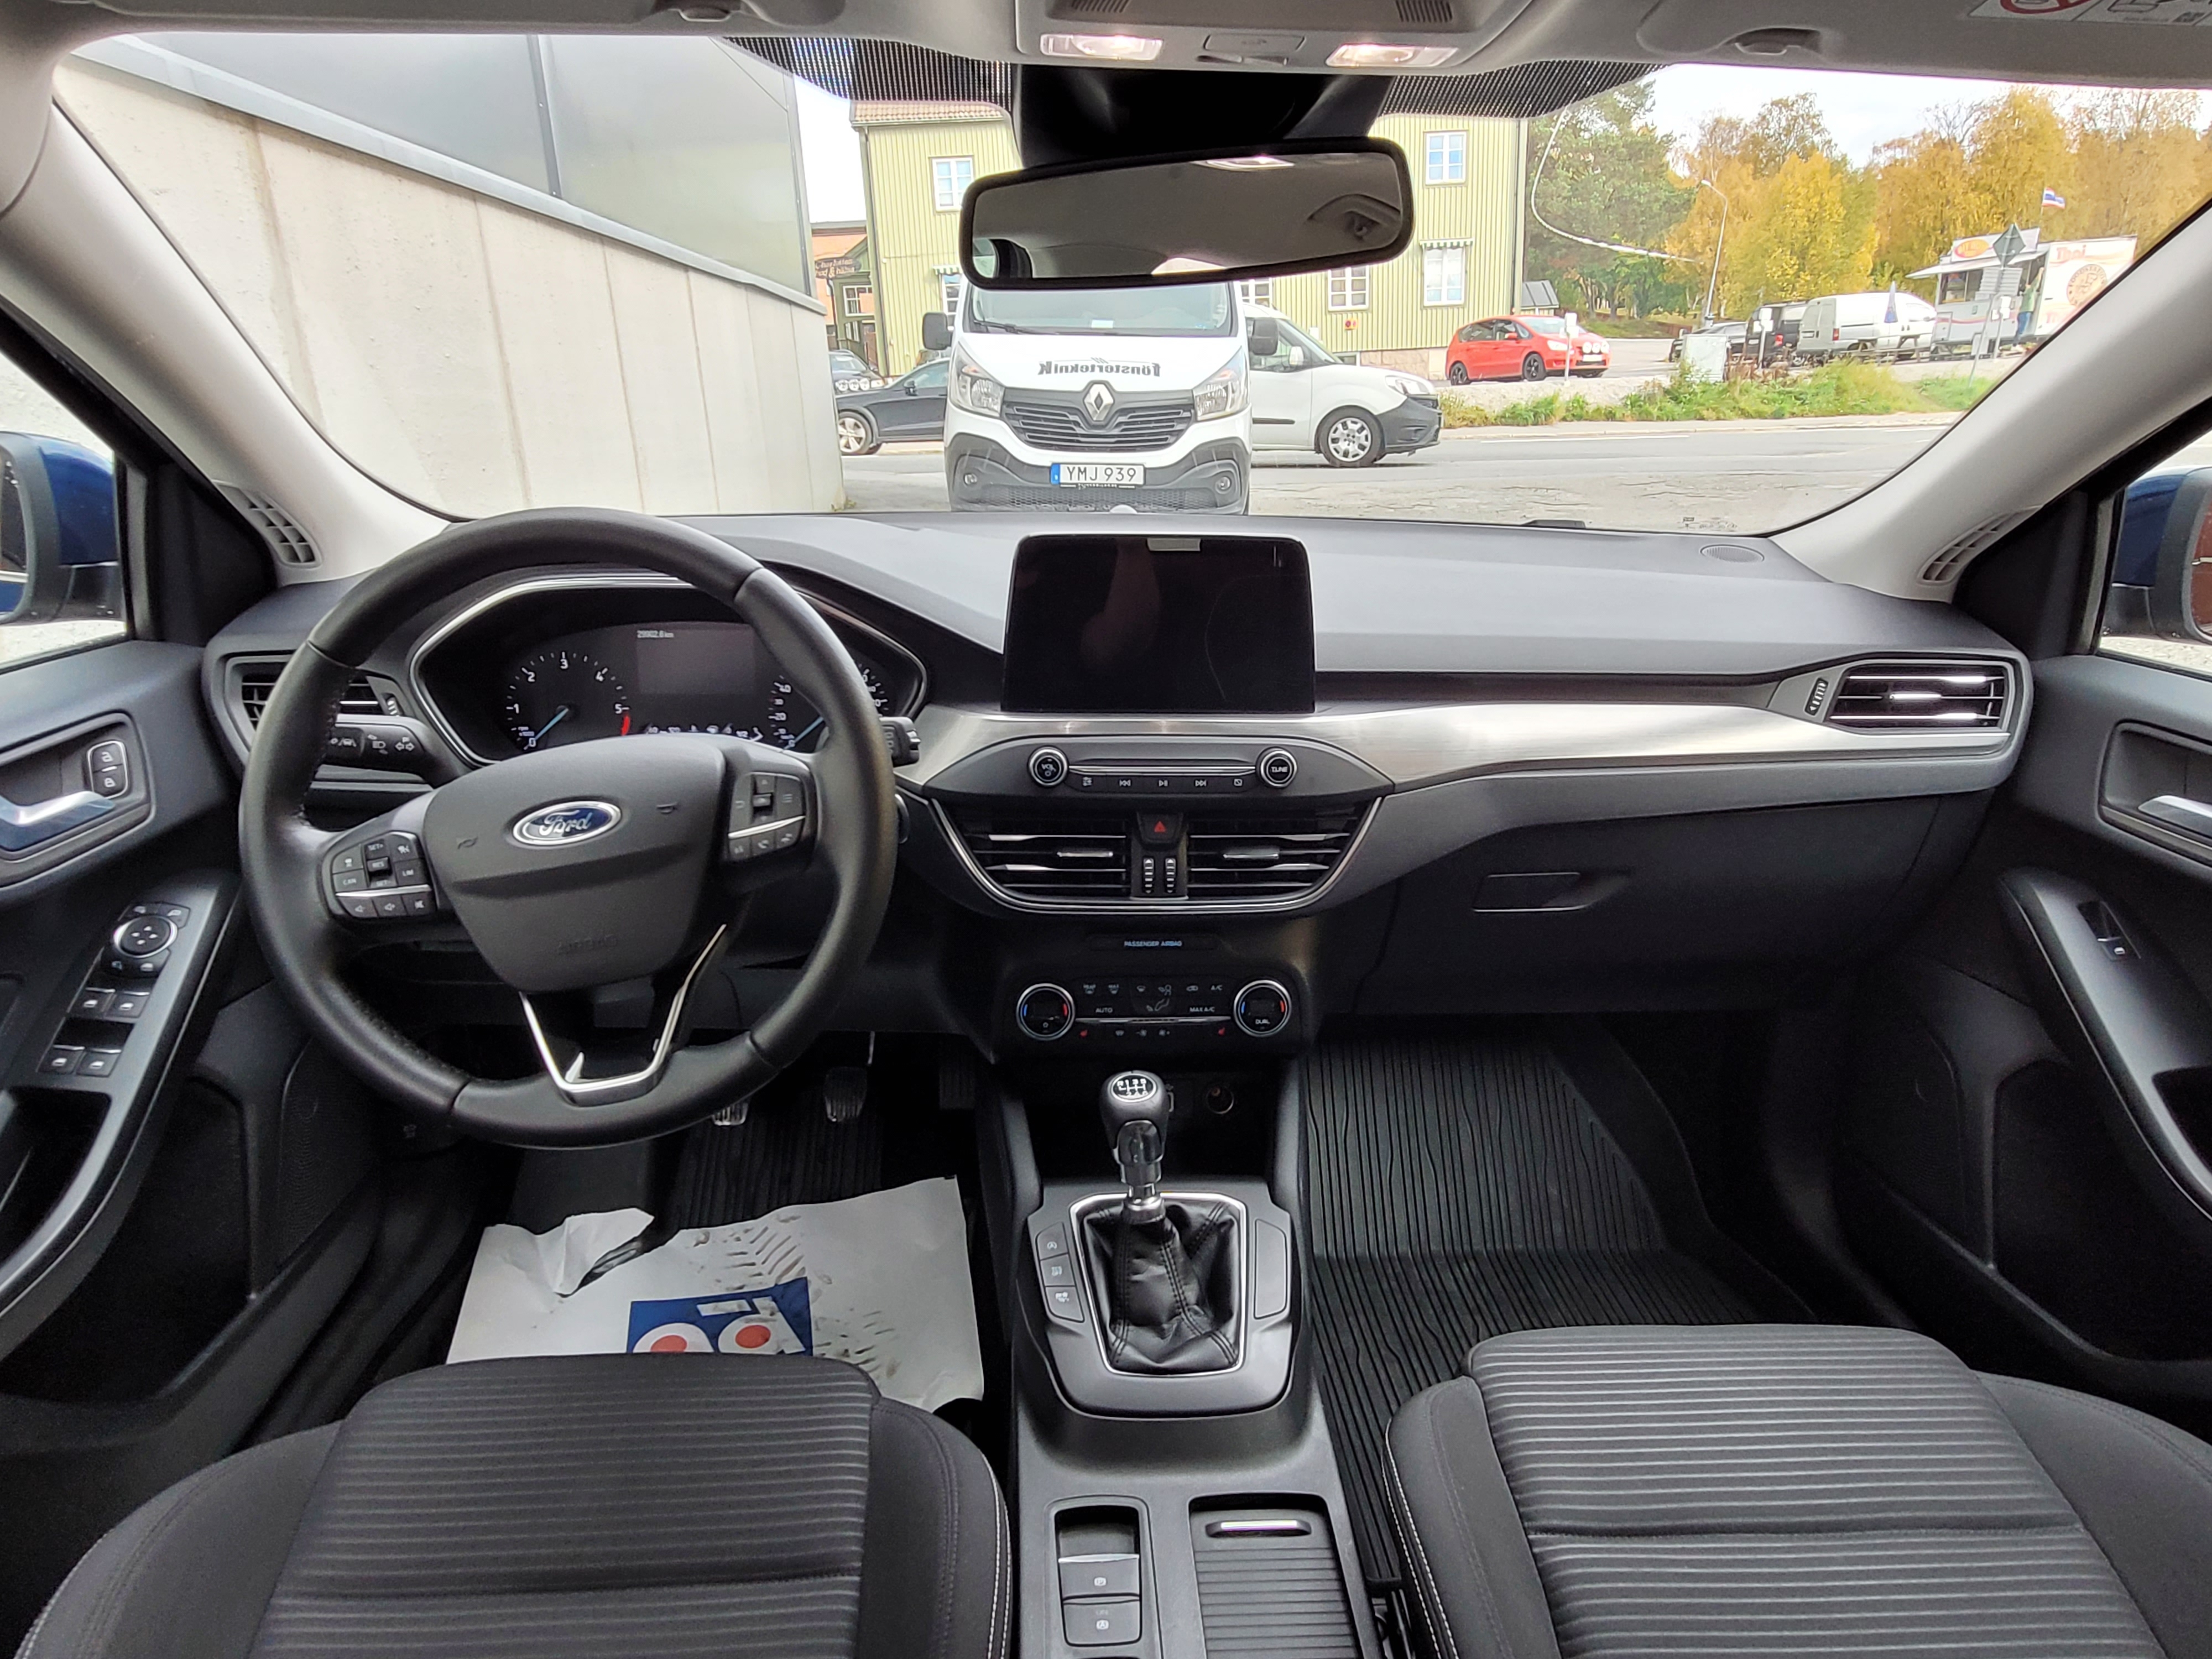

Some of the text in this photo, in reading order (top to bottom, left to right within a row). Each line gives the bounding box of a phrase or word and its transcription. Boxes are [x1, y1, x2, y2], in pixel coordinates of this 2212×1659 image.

[1067, 466, 1136, 482] YMJ 939
[560, 658, 568, 669] 3
[528, 671, 535, 682] 2
[595, 671, 604, 682] 4
[513, 703, 519, 714] 1
[615, 703, 622, 714] 5
[538, 810, 592, 836] Ford
